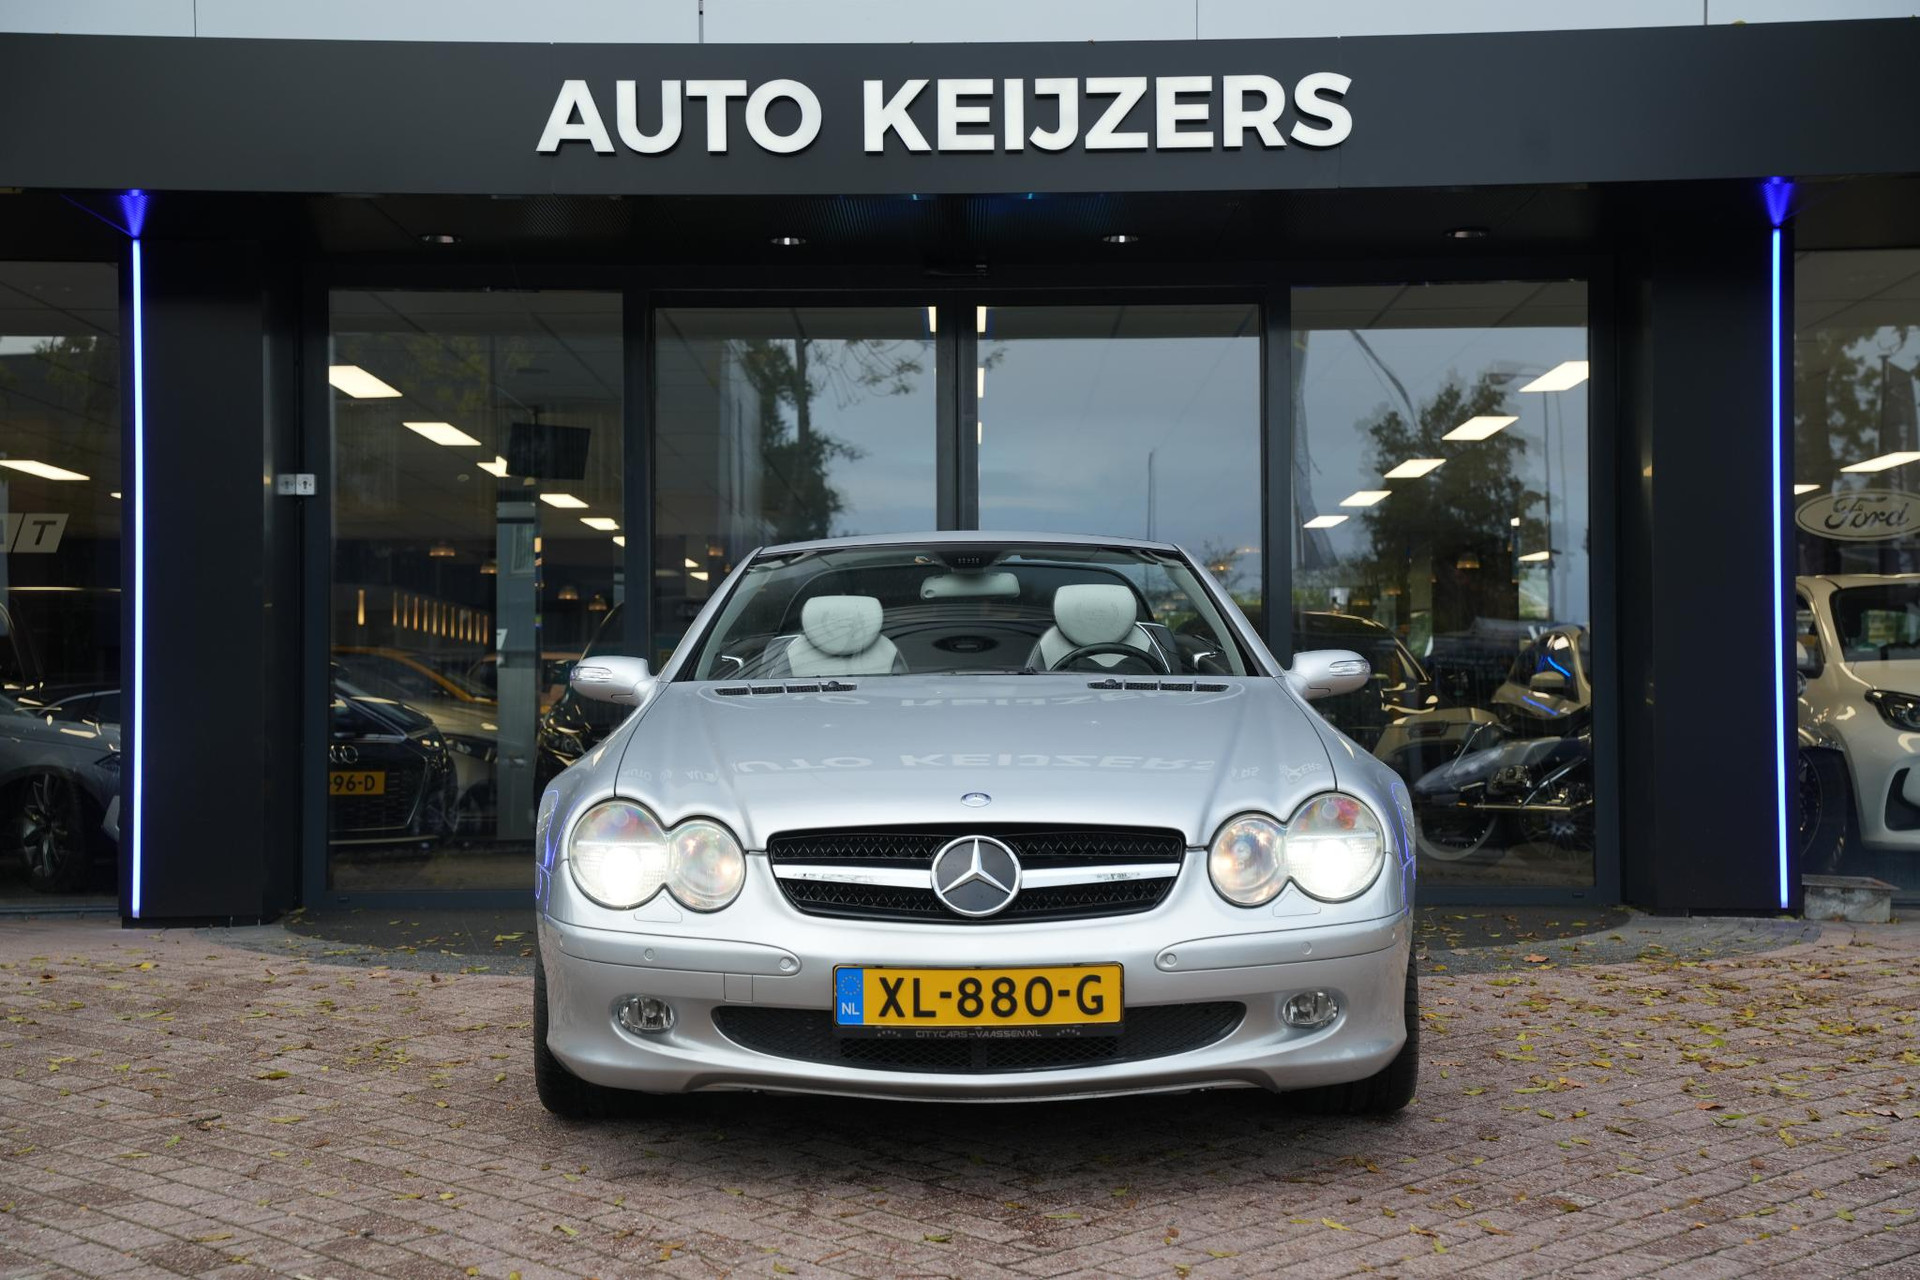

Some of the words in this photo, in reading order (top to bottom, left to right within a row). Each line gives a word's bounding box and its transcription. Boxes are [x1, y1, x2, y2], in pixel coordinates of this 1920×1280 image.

[535, 78, 822, 154] AUTO
[863, 72, 1354, 153] KEIJZERS
[1824, 496, 1910, 529] Ford
[841, 1002, 860, 1015] NL
[878, 974, 1104, 1018] XL-880-G
[915, 1029, 1042, 1039] CITYCARS-VAASSEN.NL
